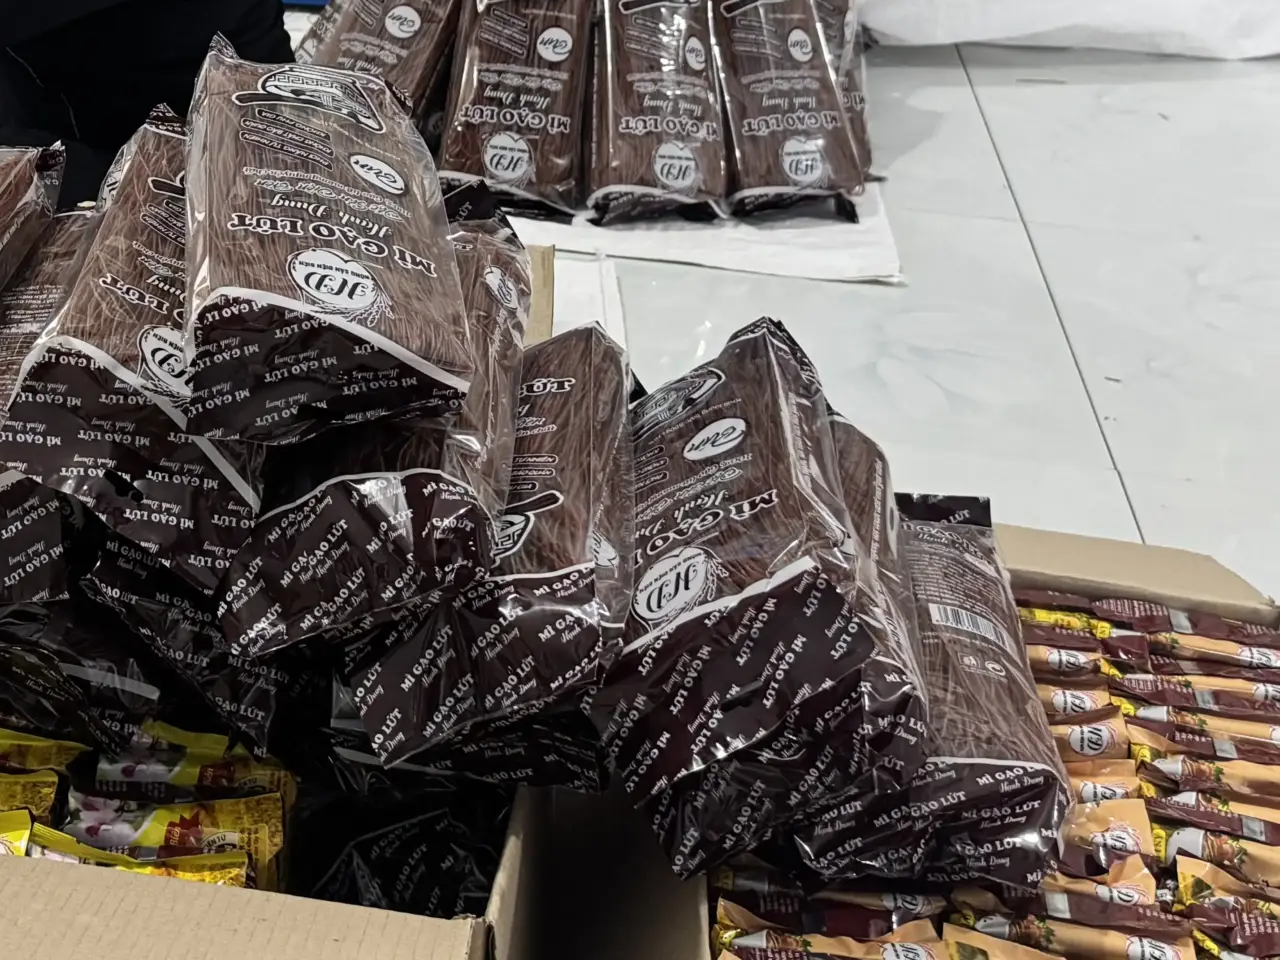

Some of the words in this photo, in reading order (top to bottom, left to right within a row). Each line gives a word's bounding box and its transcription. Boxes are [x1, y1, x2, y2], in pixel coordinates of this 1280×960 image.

[483, 85, 517, 104] Dung
[459, 104, 498, 123] LỨT
[500, 108, 545, 128] GẠO
[785, 112, 821, 129] GẠO
[822, 111, 841, 127] MÌ
[548, 114, 570, 134] MÌ
[619, 116, 660, 135] LỨT
[662, 118, 700, 135] GẠO
[742, 117, 781, 136] LỨT
[353, 157, 399, 185] Bún
[271, 194, 332, 219] Dung
[227, 213, 305, 235] LỨT
[339, 211, 394, 238] Hạnh
[309, 222, 389, 257] GẠO
[393, 246, 438, 277] MÌ
[98, 273, 170, 314] LỨT
[303, 271, 370, 301] HD
[264, 368, 291, 383] LỨT
[292, 359, 320, 375] GẠO
[519, 378, 576, 398] ỨT
[77, 429, 103, 441] LỨT
[145, 469, 171, 481] LỨT
[172, 473, 200, 487] GẠO
[123, 508, 149, 520] LỨT
[673, 489, 729, 524] Hạnh
[729, 489, 778, 521] MÌ
[150, 511, 177, 526] GẠO
[179, 516, 195, 529] MÌ
[646, 509, 724, 555] GẠO
[750, 612, 770, 638] GẠO
[830, 633, 852, 660] LỨT
[400, 677, 415, 692] MÌ
[412, 649, 435, 676] GẠO
[434, 625, 454, 651] LỨT
[775, 651, 795, 680] GẠO
[433, 695, 455, 722] GẠO
[976, 772, 994, 787] MÌ
[995, 766, 1024, 782] GẠO
